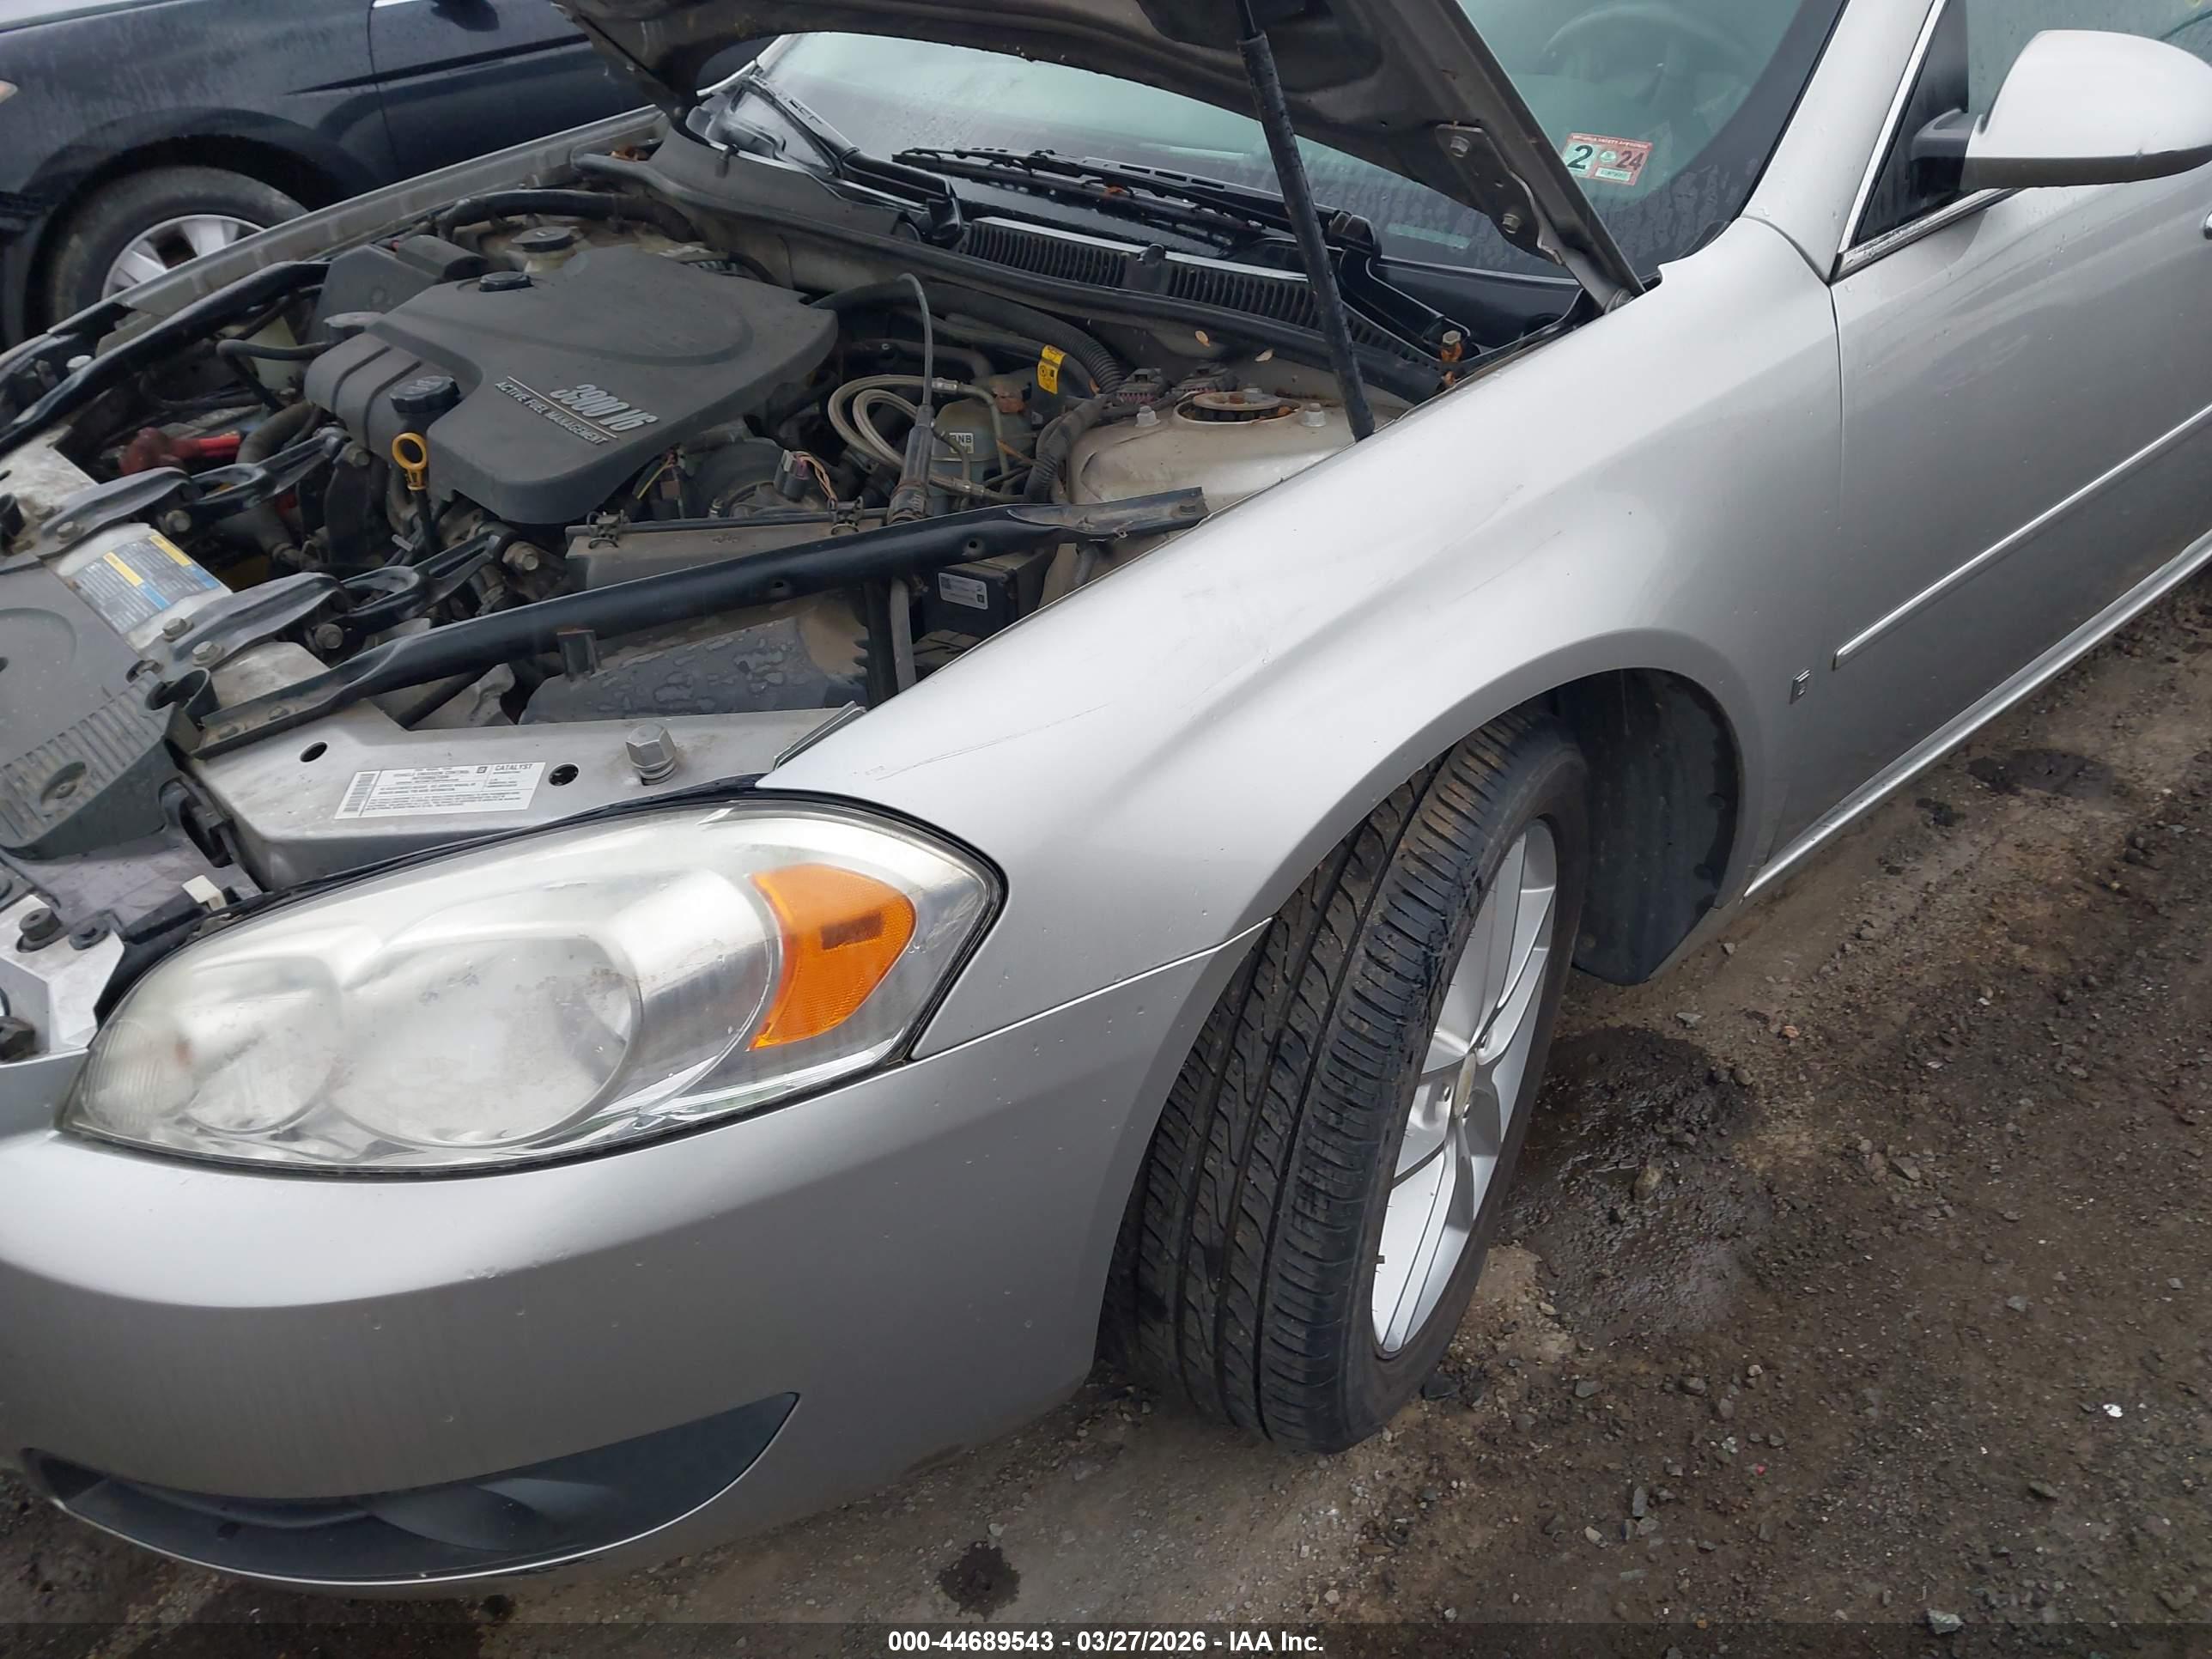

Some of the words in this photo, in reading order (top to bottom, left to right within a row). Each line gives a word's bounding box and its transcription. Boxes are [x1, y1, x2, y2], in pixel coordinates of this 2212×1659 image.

[1567, 144, 1593, 169] 2
[1616, 150, 1644, 171] 24
[494, 381, 530, 404] ACTIVE
[523, 398, 549, 415] FUEL
[544, 410, 609, 445] MANAGEMENT
[549, 384, 630, 417] 3900
[598, 409, 659, 432] V6
